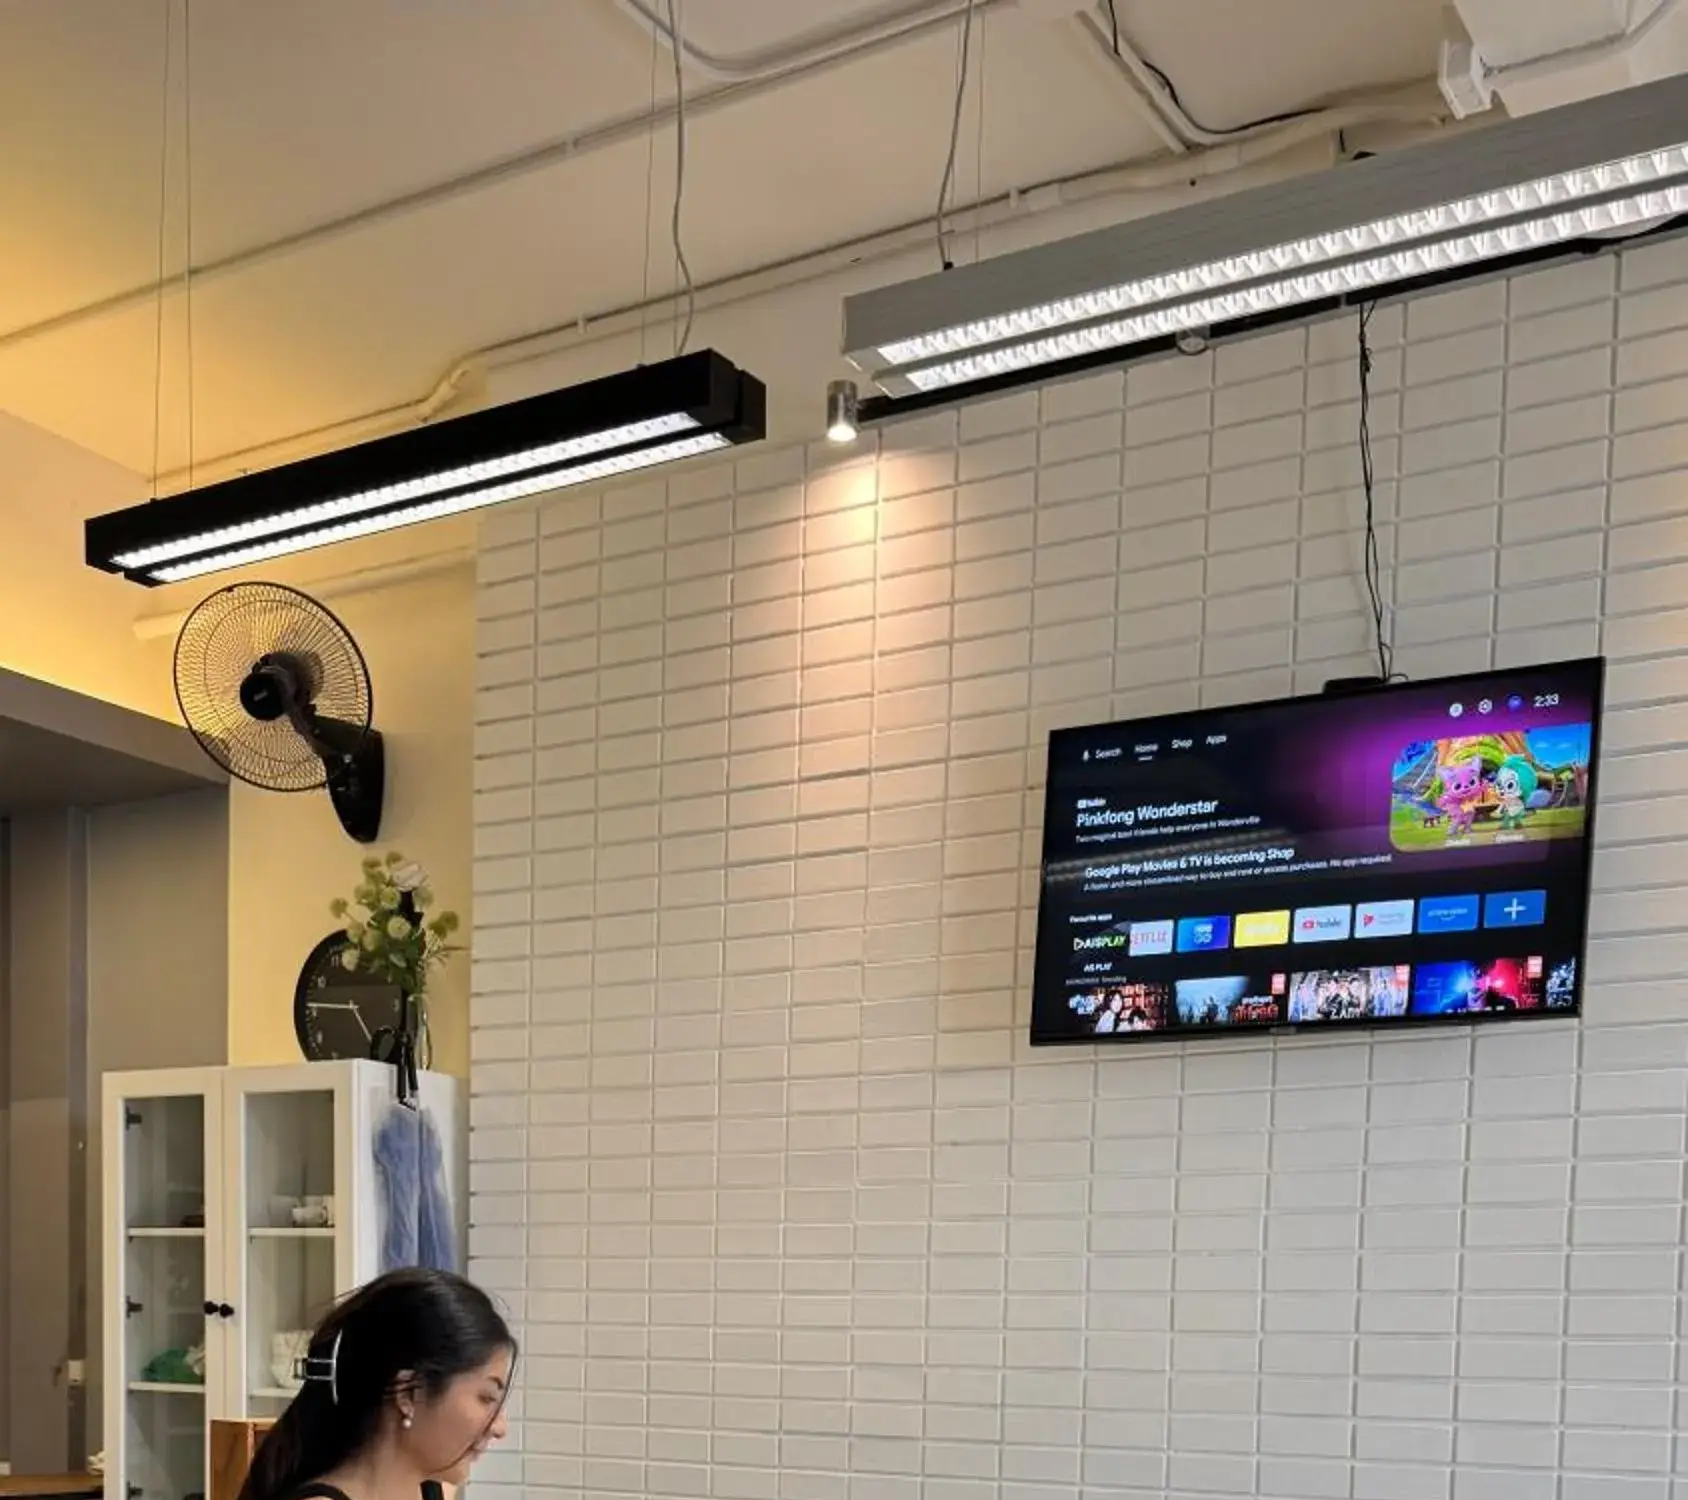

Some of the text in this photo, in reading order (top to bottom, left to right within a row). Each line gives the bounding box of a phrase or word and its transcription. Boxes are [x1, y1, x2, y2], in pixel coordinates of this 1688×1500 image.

[1533, 693, 1560, 708] 2:33
[1171, 738, 1193, 749] Shop
[1206, 734, 1228, 745] Apps
[1095, 748, 1122, 759] Search
[1134, 743, 1159, 754] Home
[1076, 800, 1219, 828] Pinkfong Wonderstar
[1085, 848, 1295, 879] Google Play Movies & TV is becoming Shop
